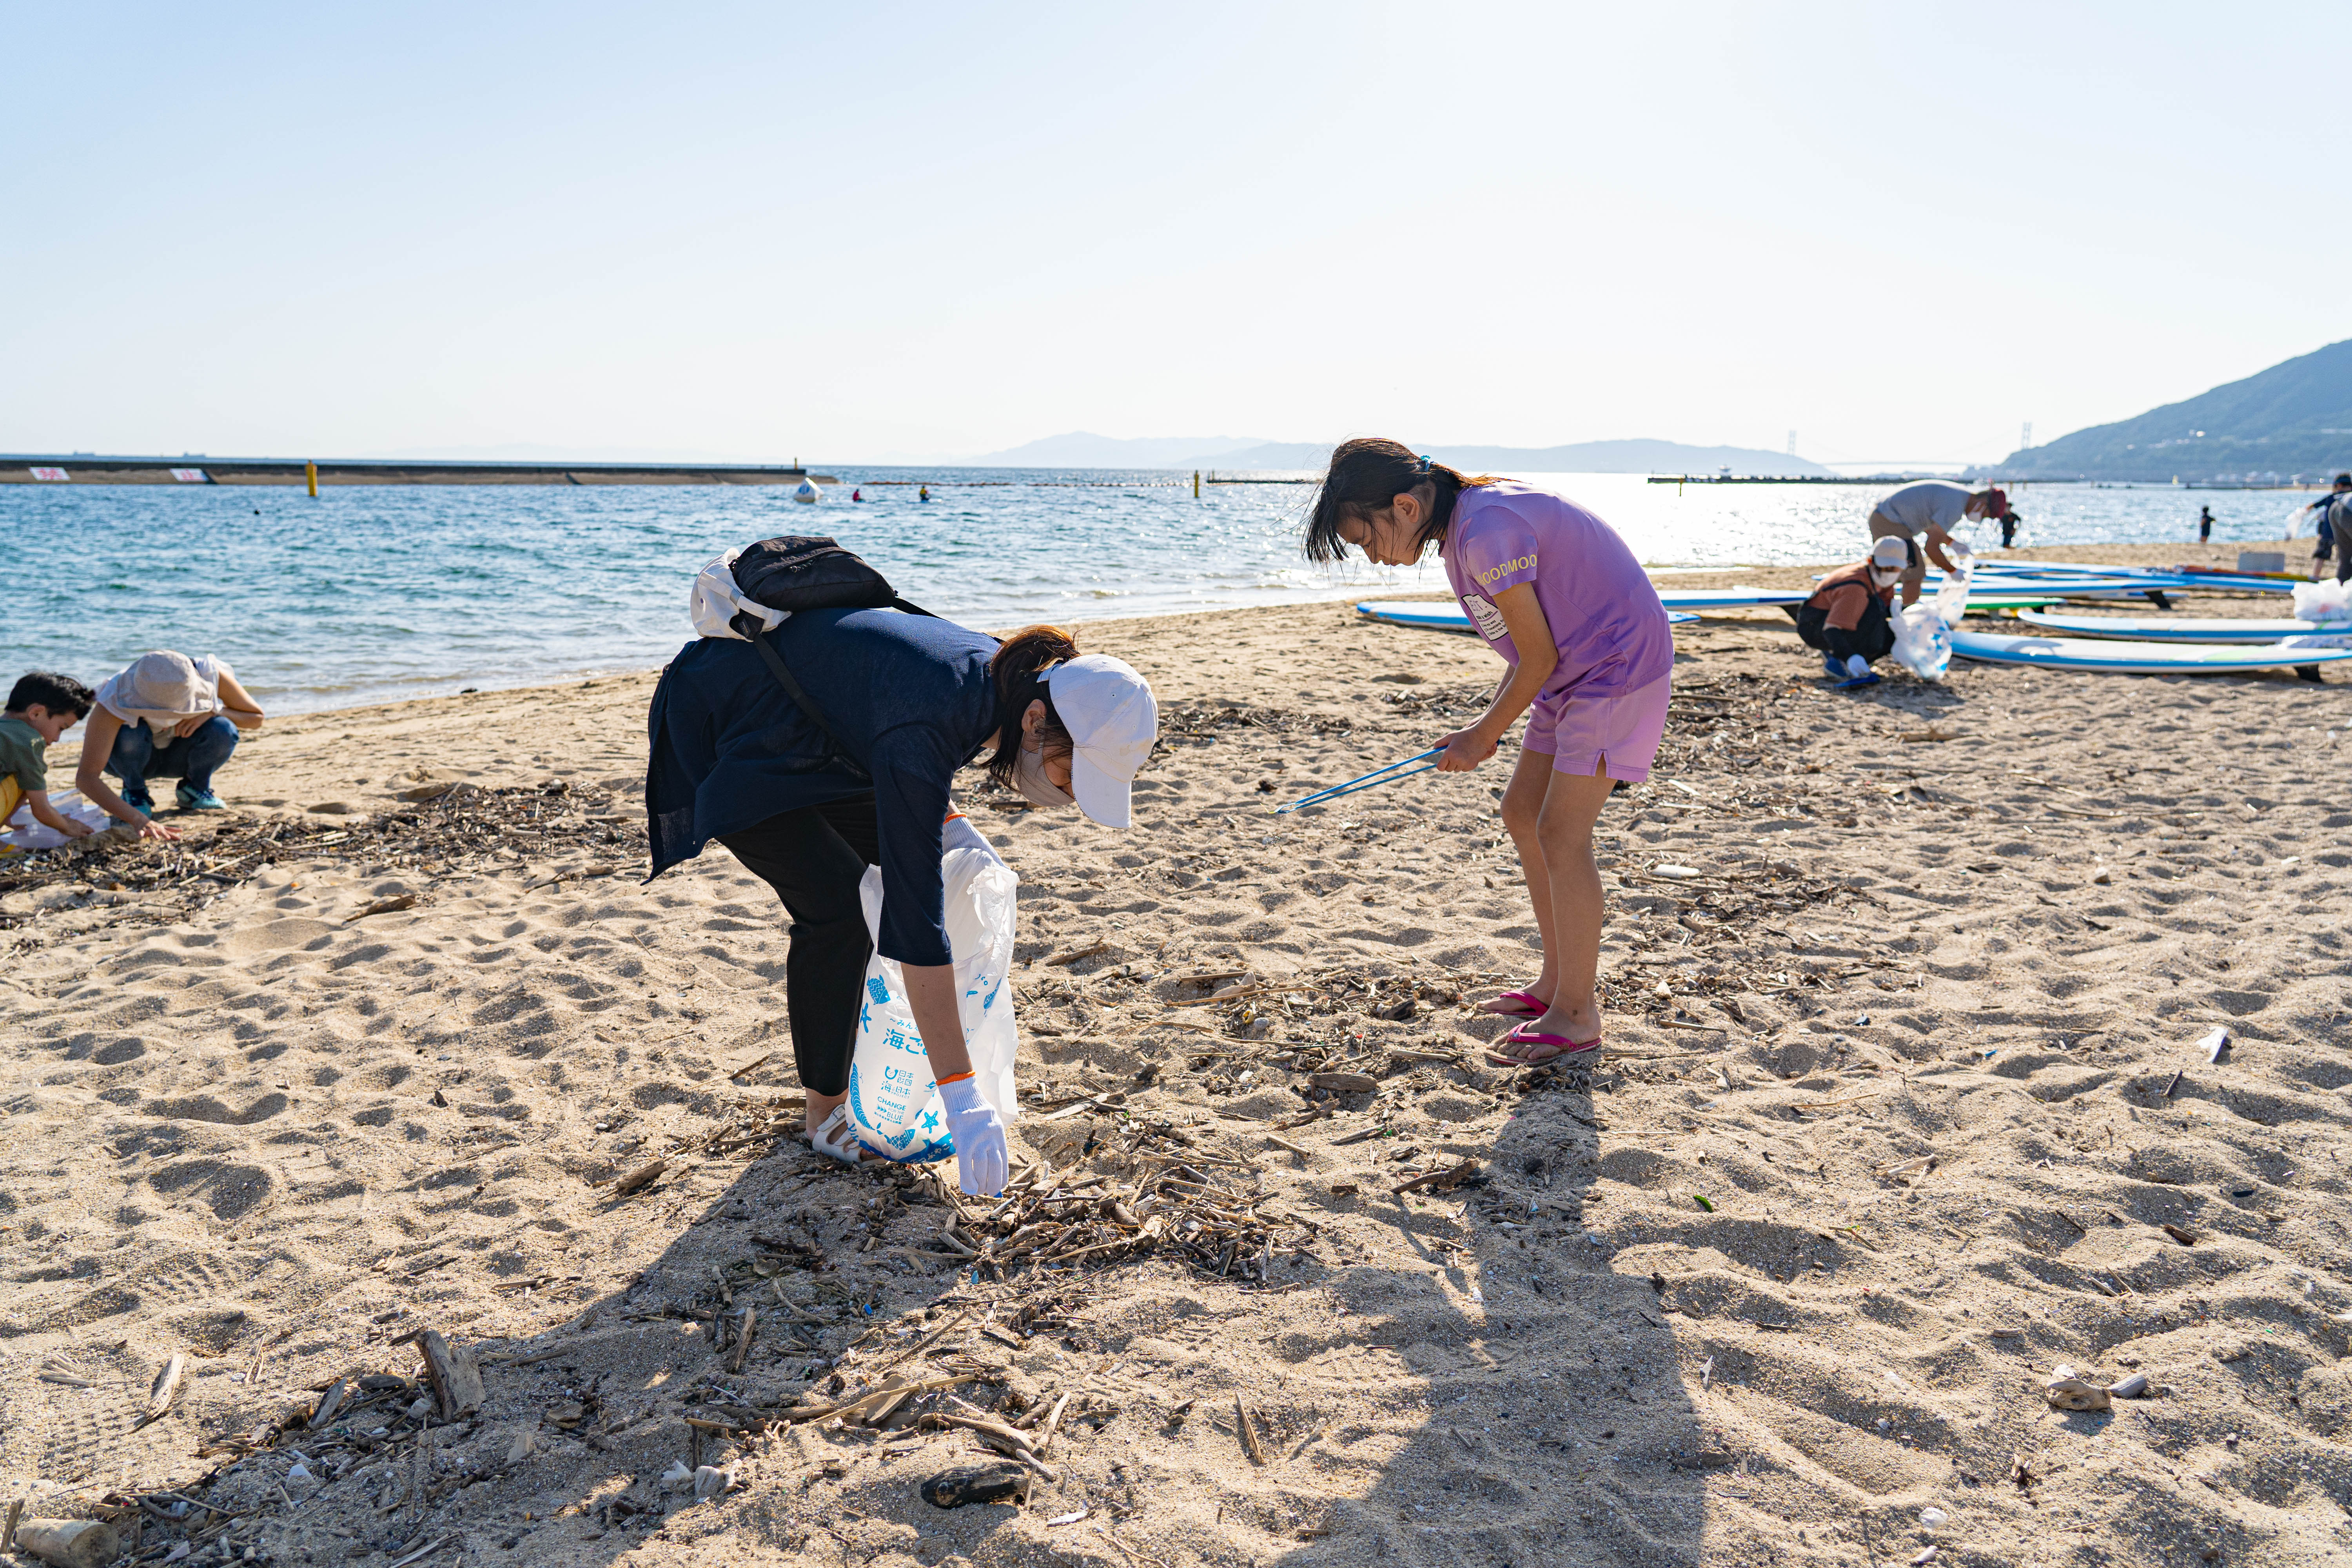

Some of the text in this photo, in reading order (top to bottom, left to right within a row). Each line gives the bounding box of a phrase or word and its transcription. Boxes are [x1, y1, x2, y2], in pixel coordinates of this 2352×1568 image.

[883, 1028, 928, 1055] 海ご
[899, 1070, 914, 1078] 日本
[881, 1081, 911, 1095] 海と日本
[878, 1096, 906, 1111] CHANGE
[887, 1112, 904, 1121] BLUE
